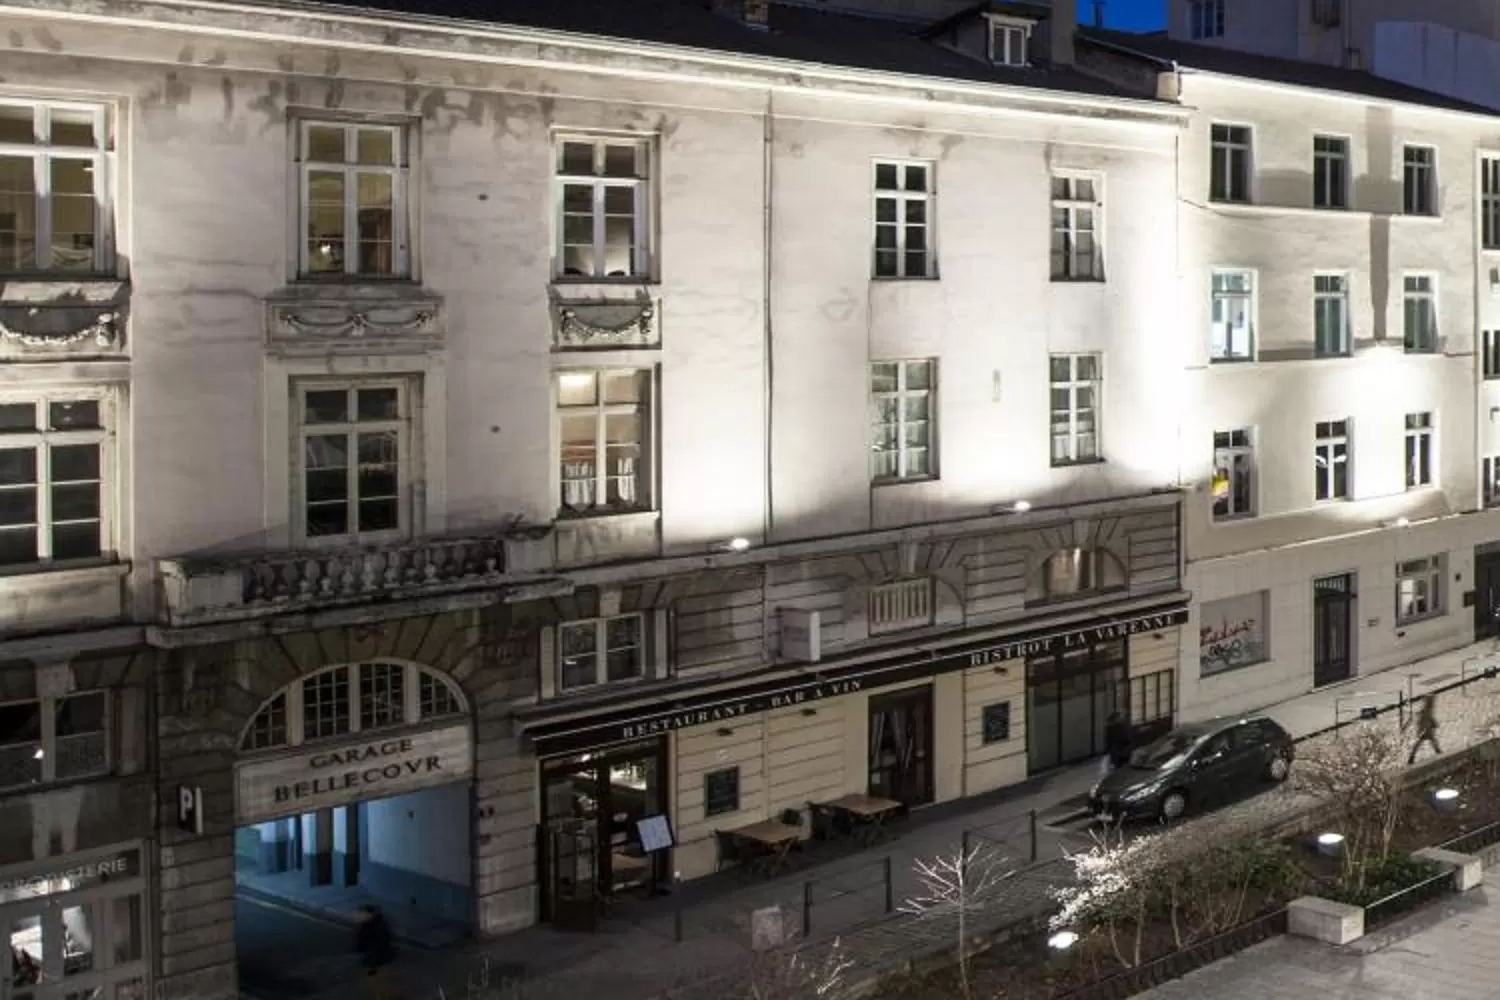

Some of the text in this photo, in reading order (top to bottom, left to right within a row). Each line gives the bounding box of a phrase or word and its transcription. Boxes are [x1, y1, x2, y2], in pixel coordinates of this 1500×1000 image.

[971, 638, 1054, 666] BISTROT
[1064, 632, 1087, 649] LA
[1095, 613, 1175, 641] VARENNE
[622, 703, 748, 739] RESTAURANT
[771, 689, 805, 708] BAR
[831, 680, 862, 697] VIN
[310, 739, 413, 770] GARAGE
